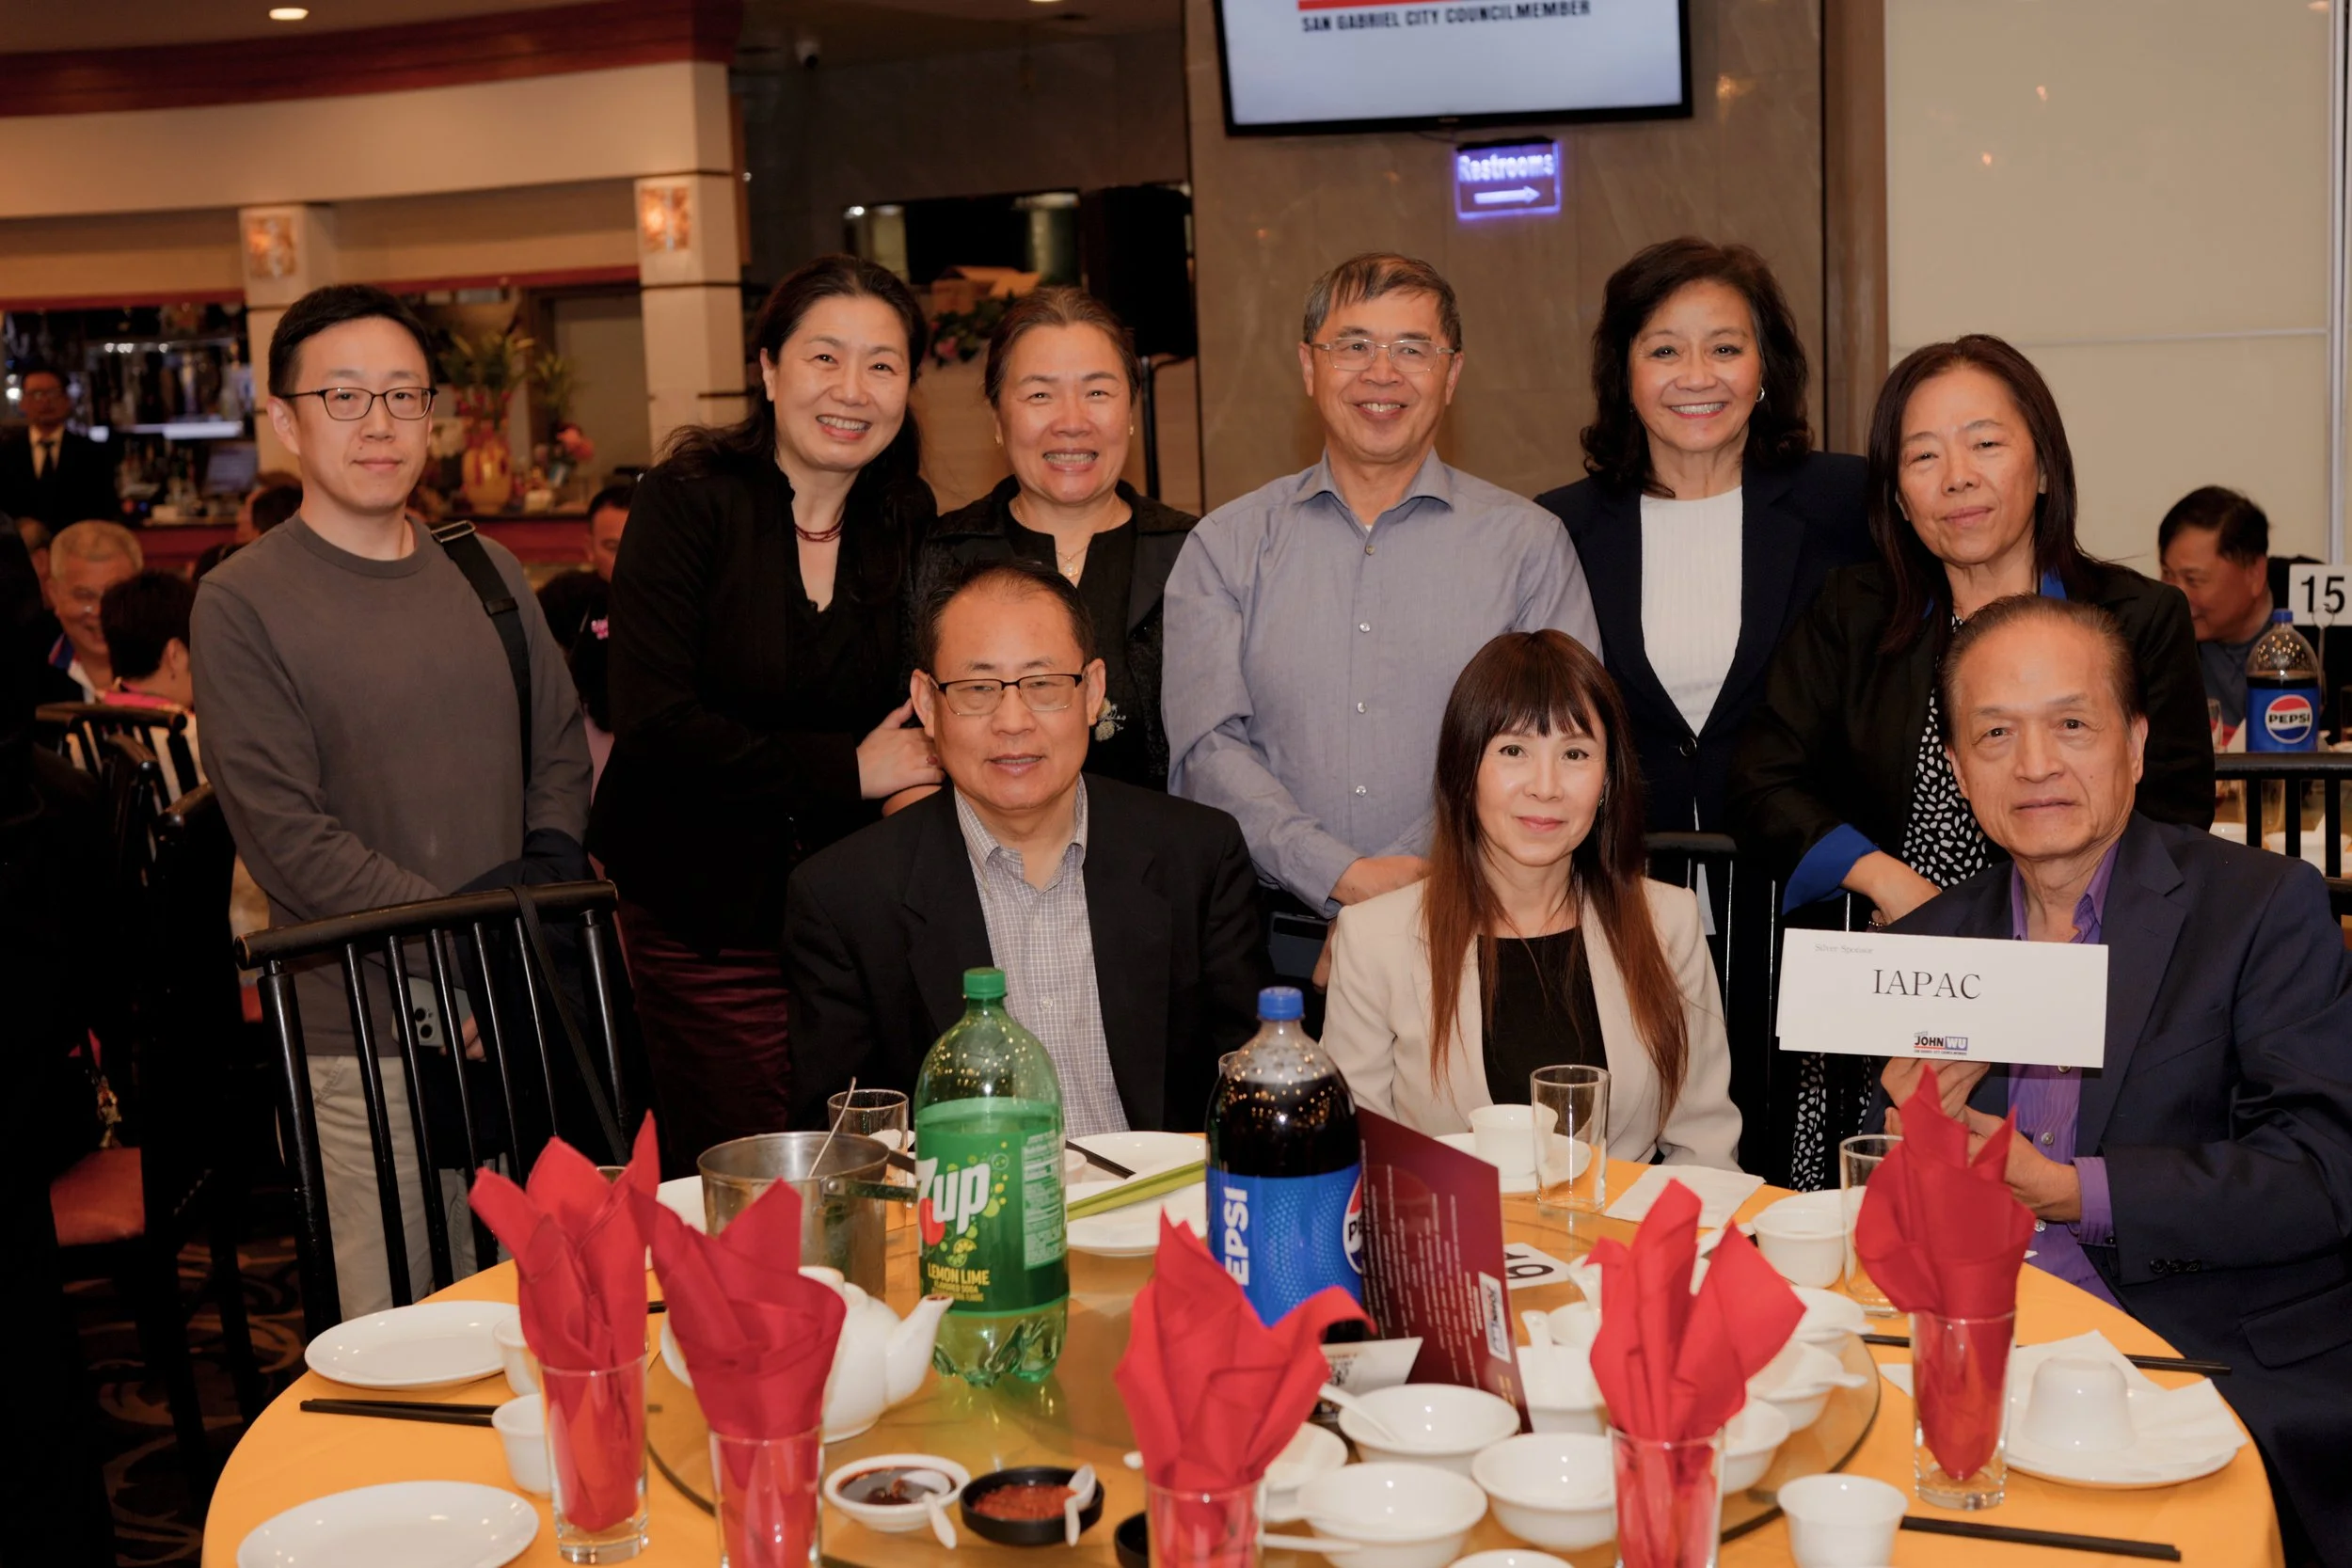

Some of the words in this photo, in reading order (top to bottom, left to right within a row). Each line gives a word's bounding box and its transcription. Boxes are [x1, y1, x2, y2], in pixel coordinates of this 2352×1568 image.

[1301, 16, 1331, 32] SAN
[1337, 12, 1401, 30] GABRIEL
[1405, 8, 1439, 26] CITY
[1445, 1, 1591, 24] COUNCILMEMBER
[1459, 153, 1555, 182] Restrooms
[2301, 575, 2345, 614] 15
[2268, 712, 2311, 724] PEPSI
[1872, 969, 1981, 1000] IAPAC
[1915, 1036, 1944, 1047] JOHN
[1946, 1037, 1967, 1049] WU
[1224, 1186, 1249, 1287] EPSI
[928, 1262, 960, 1284] LEMON
[961, 1268, 991, 1286] LIME
